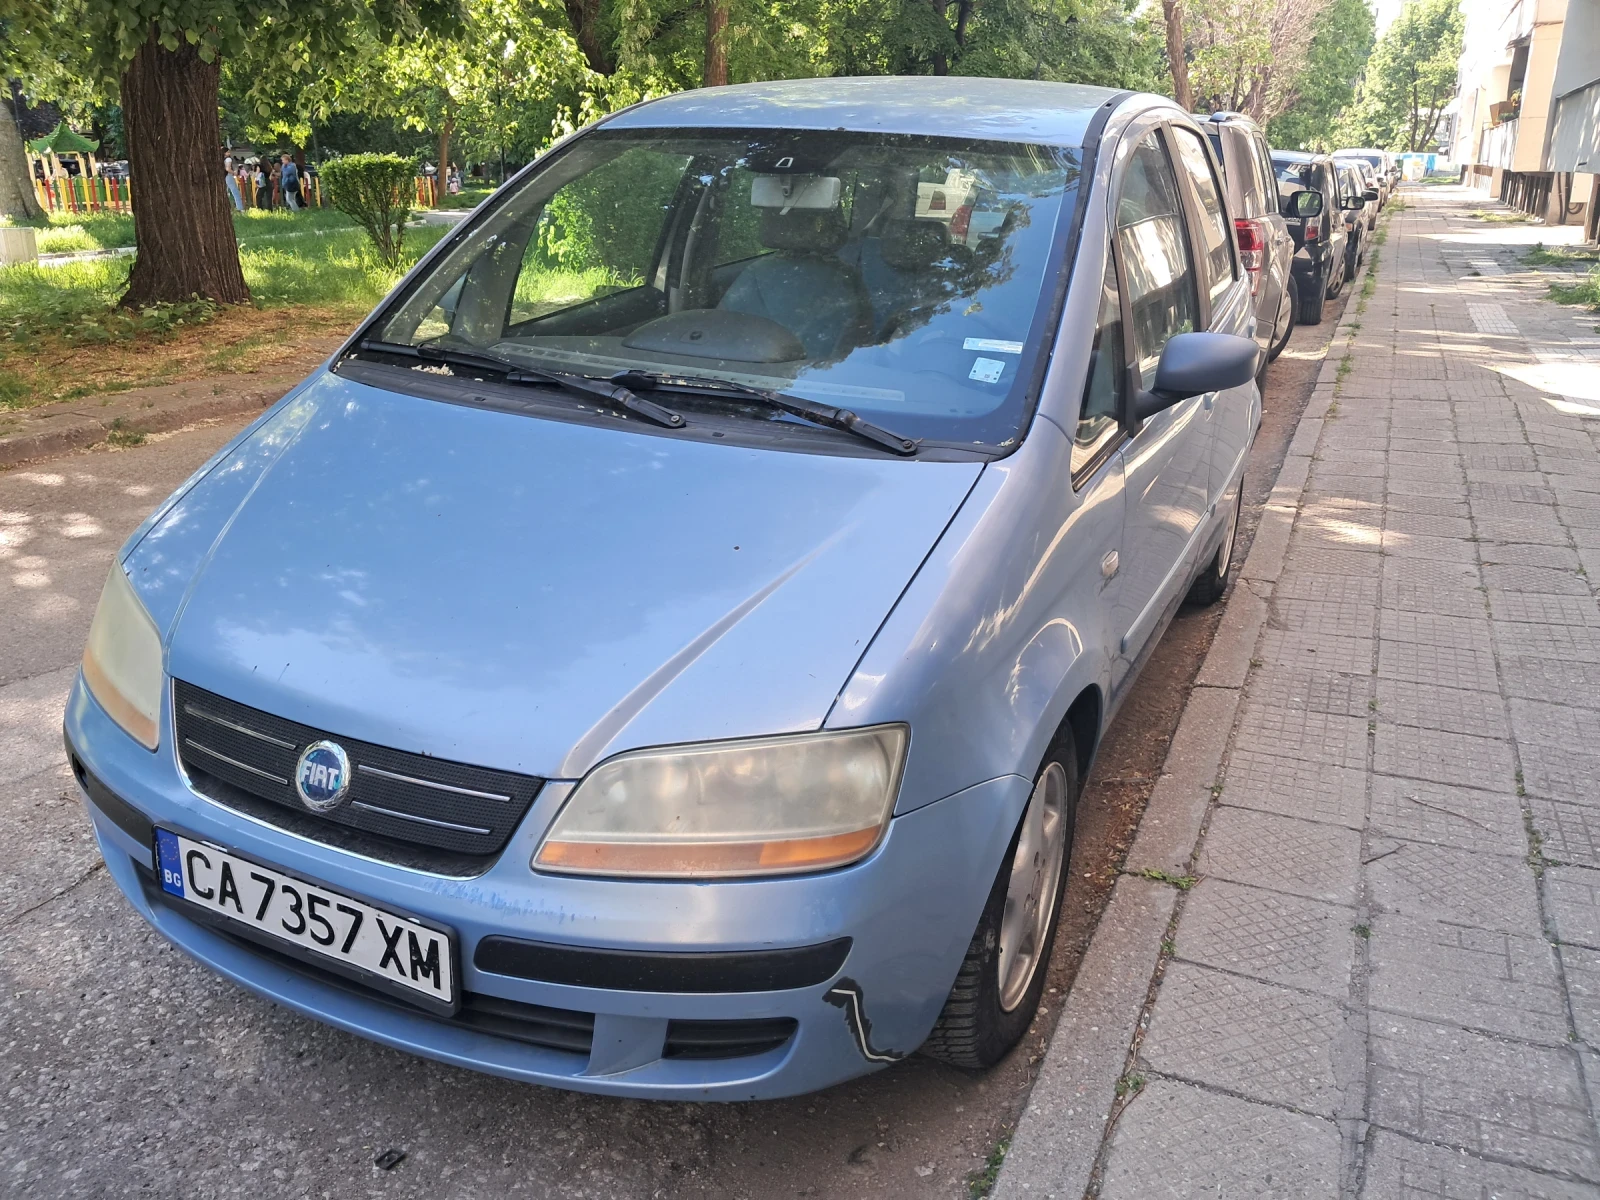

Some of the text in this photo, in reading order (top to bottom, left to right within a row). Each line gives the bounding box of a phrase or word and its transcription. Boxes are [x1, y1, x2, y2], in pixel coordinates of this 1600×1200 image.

[301, 760, 339, 790] FIAT
[164, 868, 182, 887] BG
[186, 849, 441, 990] CA 7357 XM
